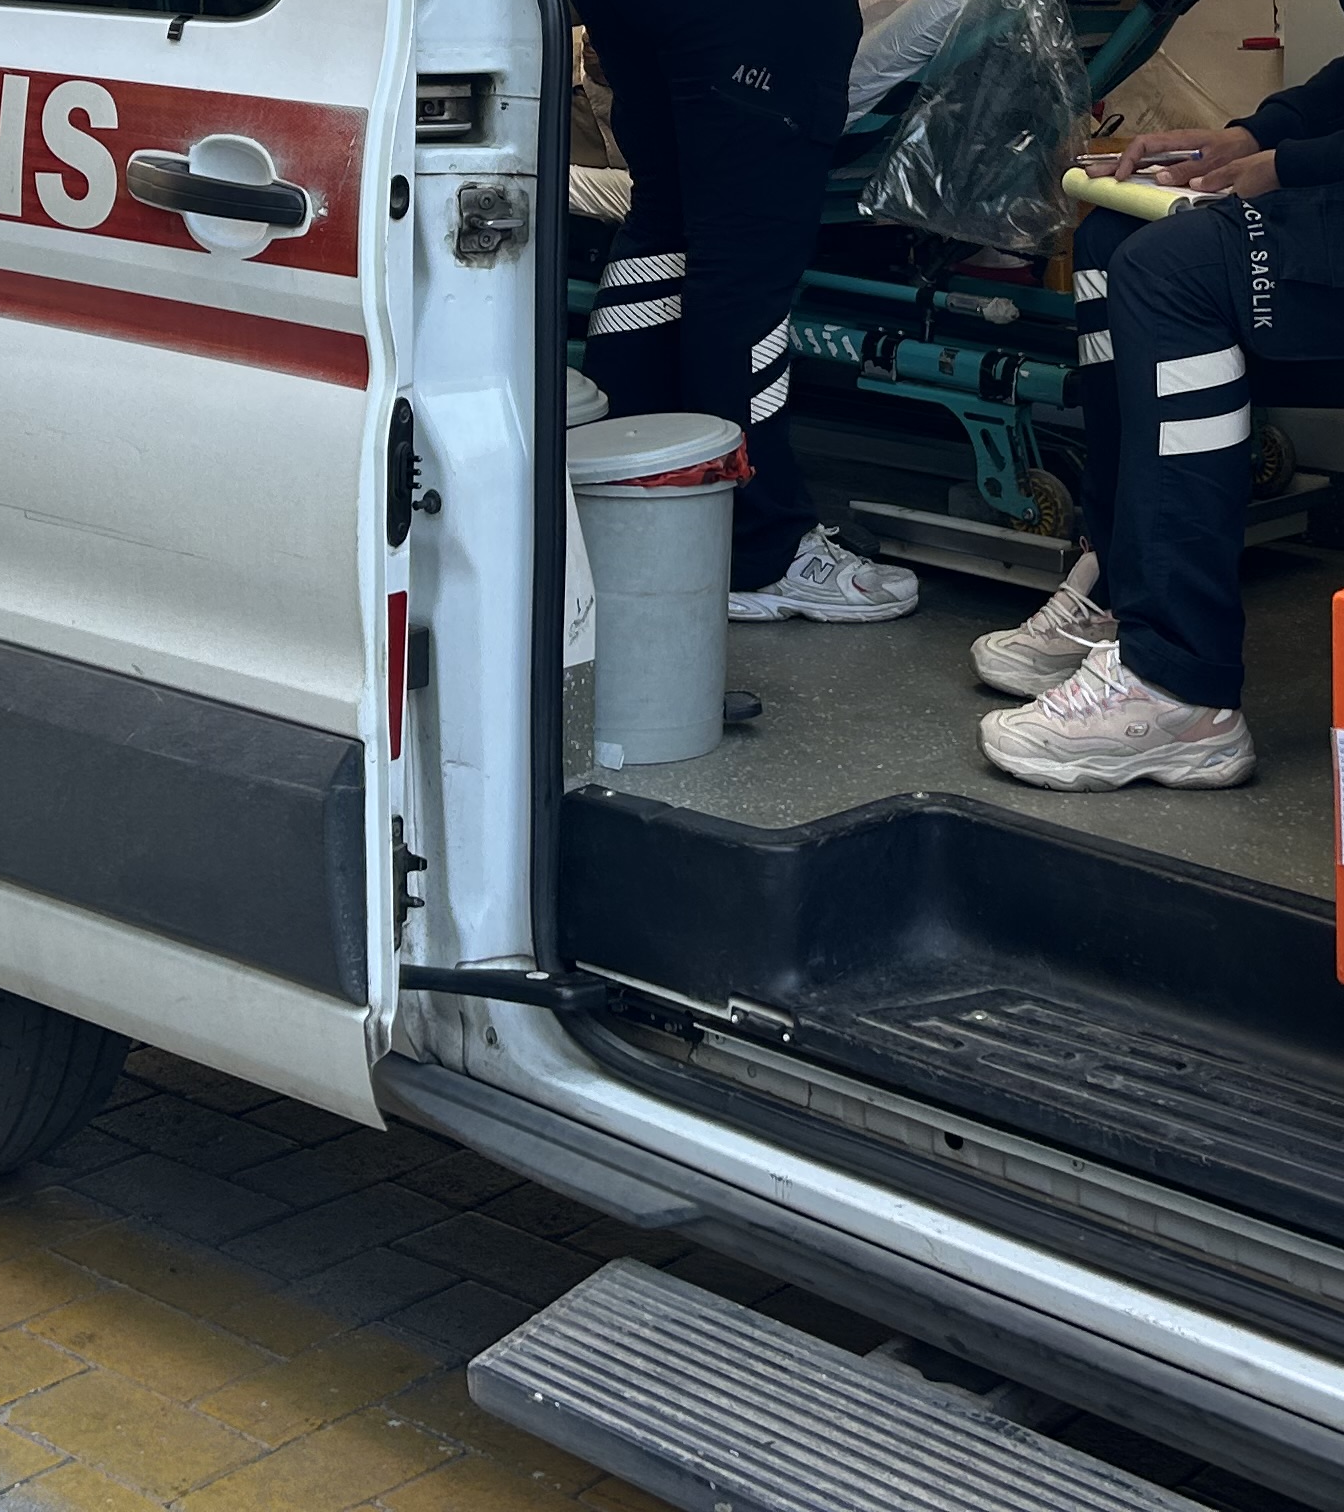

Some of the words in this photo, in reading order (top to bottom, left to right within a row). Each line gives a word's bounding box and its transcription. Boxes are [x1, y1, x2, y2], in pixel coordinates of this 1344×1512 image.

[732, 64, 770, 91] ACİL
[1251, 251, 1276, 328] SAĞLIK
[800, 556, 835, 585] N
